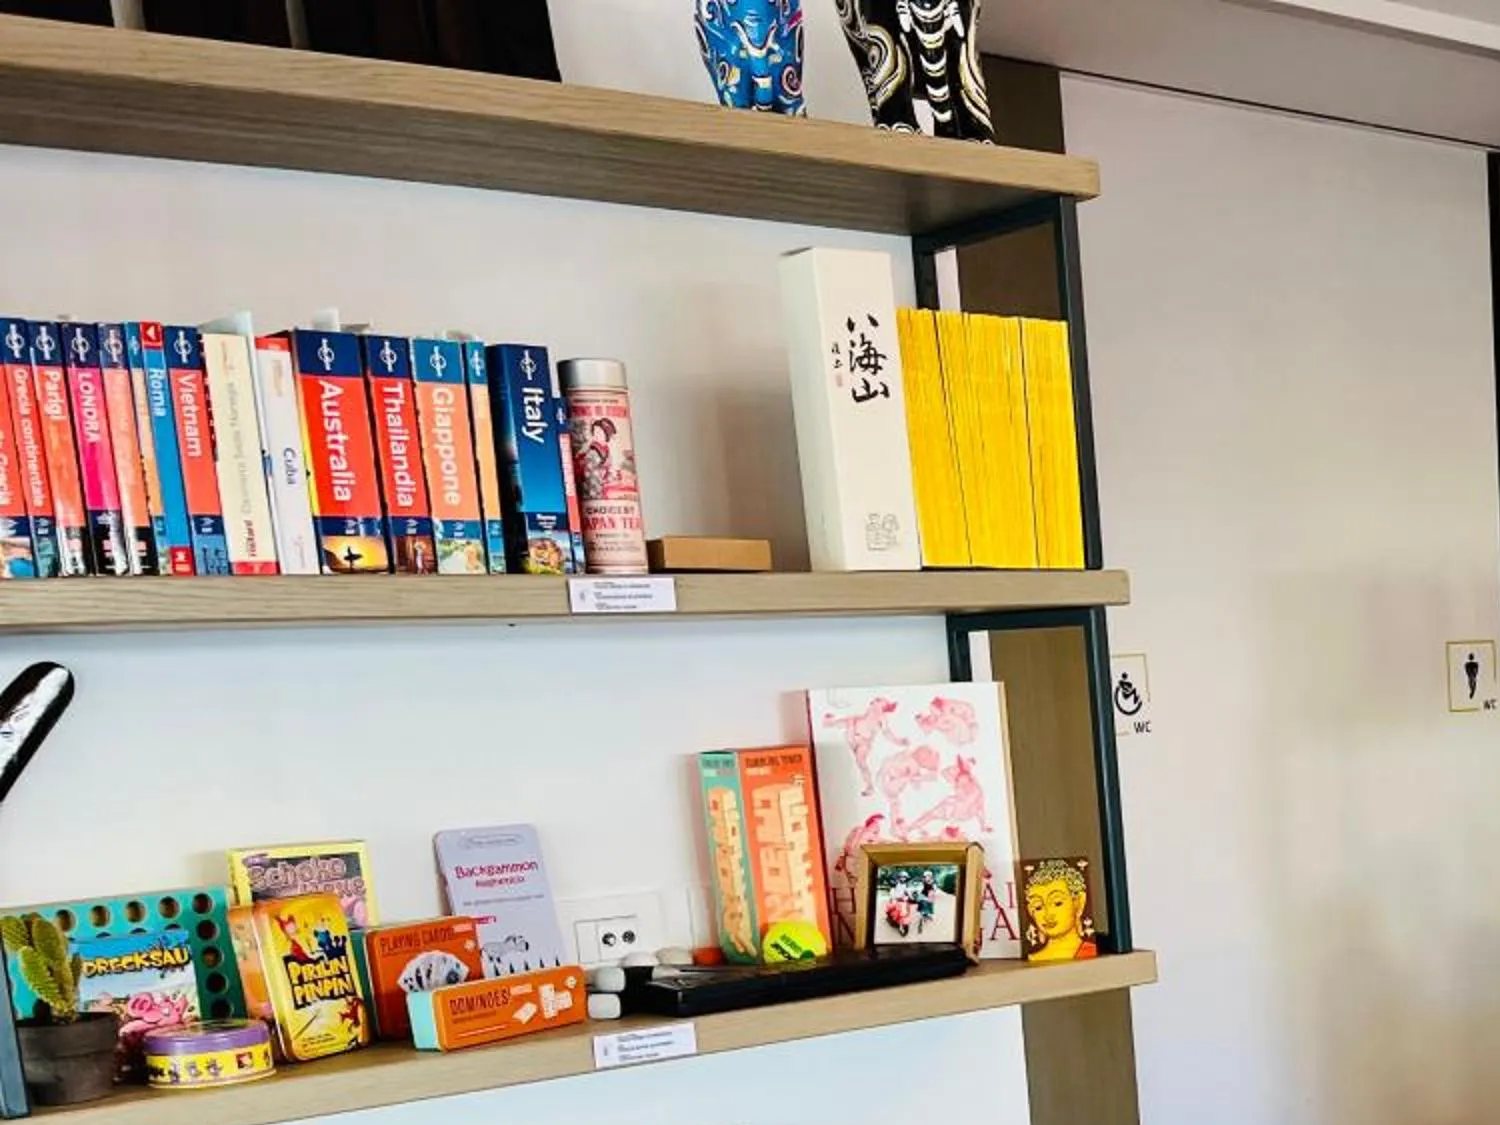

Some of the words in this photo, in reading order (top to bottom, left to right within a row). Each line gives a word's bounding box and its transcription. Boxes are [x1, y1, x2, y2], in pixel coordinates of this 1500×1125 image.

[846, 311, 891, 403] 八海山
[16, 367, 31, 415] Grecia
[44, 369, 66, 421] Parigi
[77, 372, 101, 444] LONDRA
[149, 367, 167, 417] Roma
[176, 373, 203, 457] Vietnam
[521, 387, 552, 444] Italy
[21, 418, 46, 507] continentale
[282, 447, 297, 486] Cuba
[319, 379, 353, 502] Australia
[382, 385, 414, 507] Thailandia
[431, 387, 463, 506] Giappone
[1133, 720, 1152, 734] WC
[1483, 699, 1498, 711] WC
[454, 860, 539, 880] Backgammon
[82, 947, 191, 978] DRECKSAU
